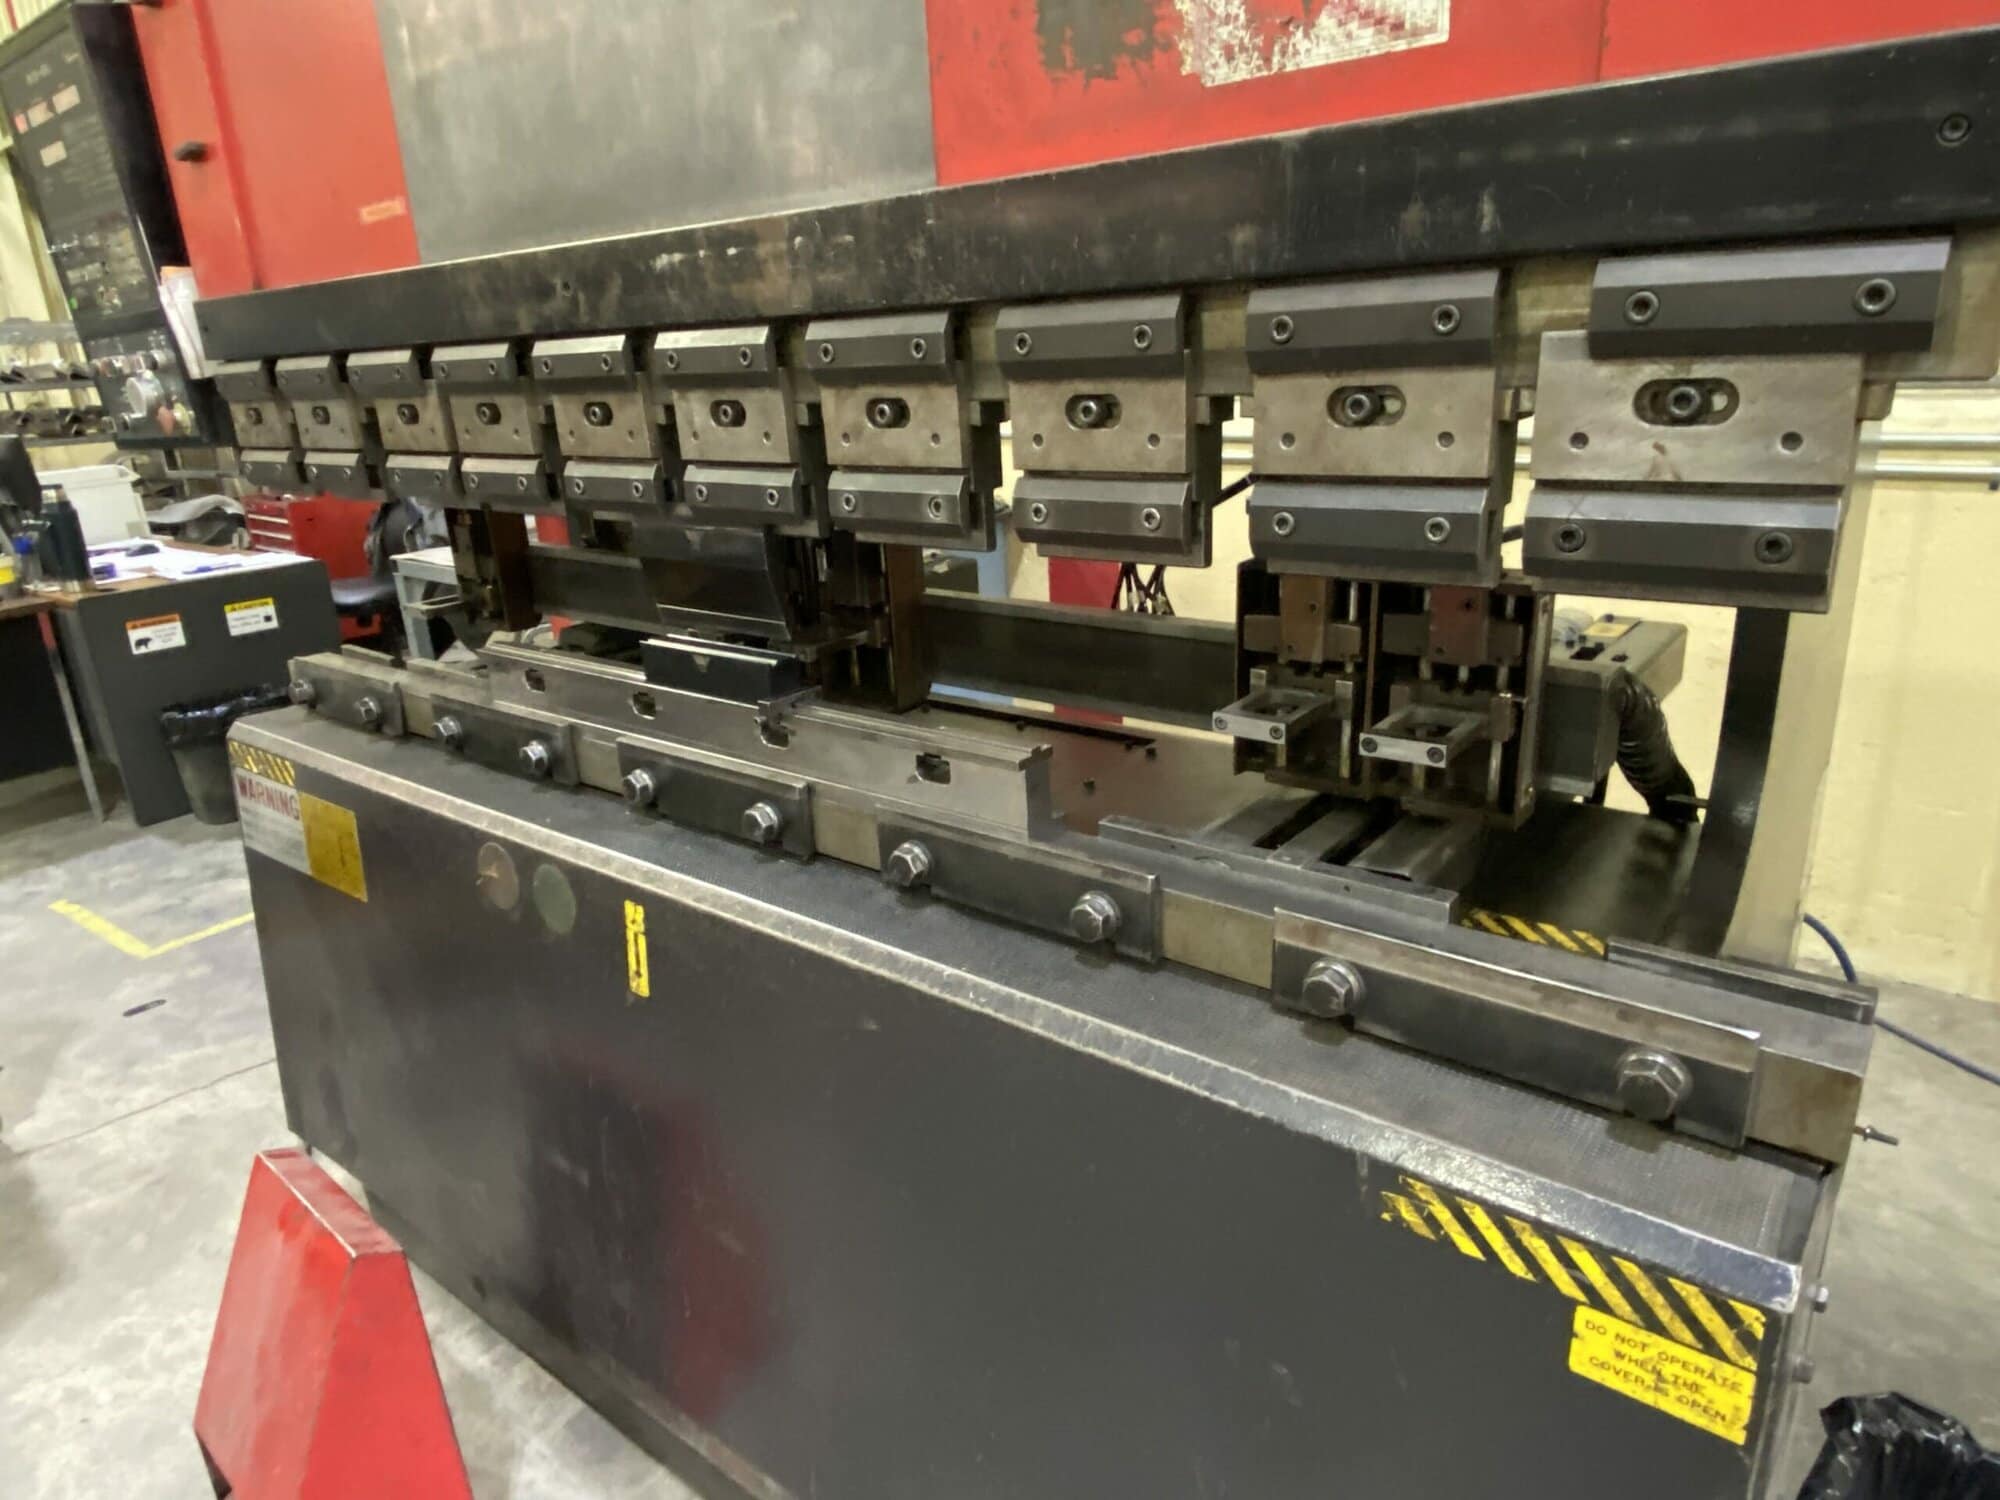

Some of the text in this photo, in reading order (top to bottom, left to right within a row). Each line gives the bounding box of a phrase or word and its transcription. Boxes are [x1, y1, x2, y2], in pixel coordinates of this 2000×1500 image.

[238, 774, 300, 820] WARNING
[1585, 1319, 1743, 1394] DO NOT OPERATE
[1613, 1349, 1662, 1378] WHEN
[1588, 1355, 1645, 1388] COVER
[1676, 1394, 1727, 1423] OPEN
